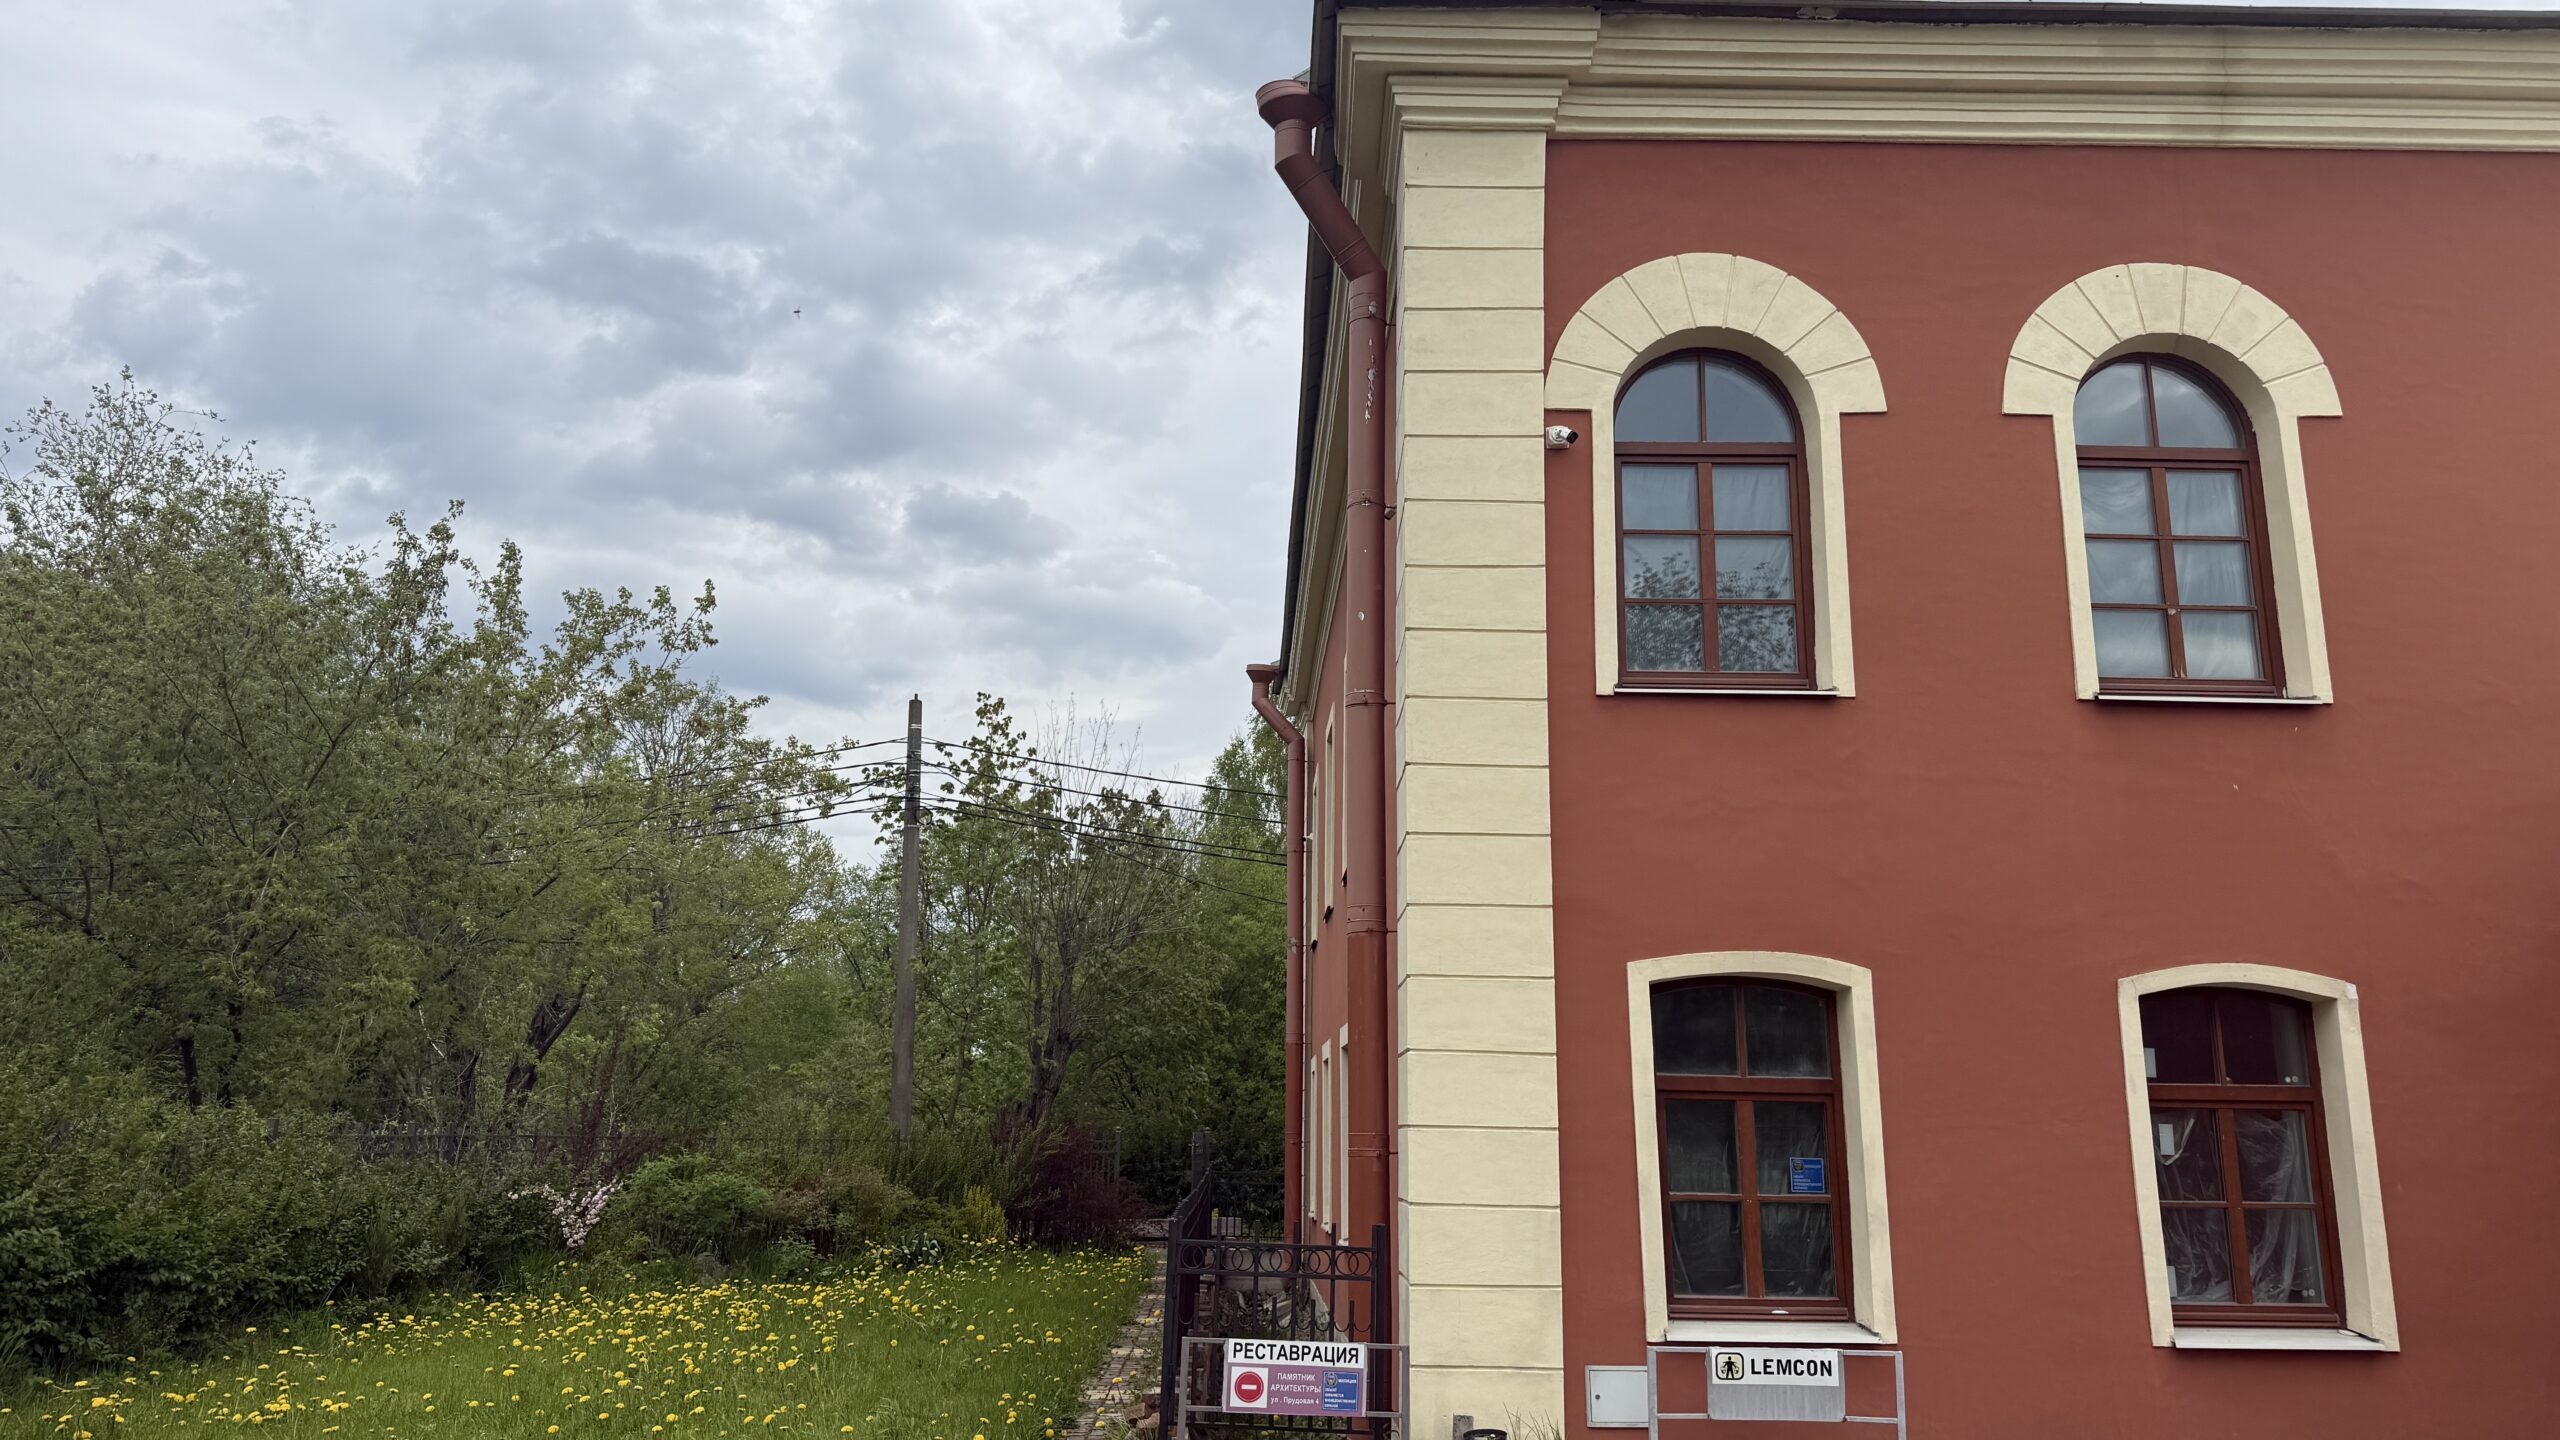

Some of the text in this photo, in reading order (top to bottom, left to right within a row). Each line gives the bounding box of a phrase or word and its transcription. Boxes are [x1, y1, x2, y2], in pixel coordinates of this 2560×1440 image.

[1233, 1342, 1359, 1366] РЕСТАВРАЦИЯ
[1750, 1358, 1832, 1377] LEMCON
[1277, 1372, 1316, 1381] ПАМЯТНИК
[1270, 1384, 1321, 1393] АРХИТЕКТУРЫ
[1283, 1396, 1314, 1406] Прудовая
